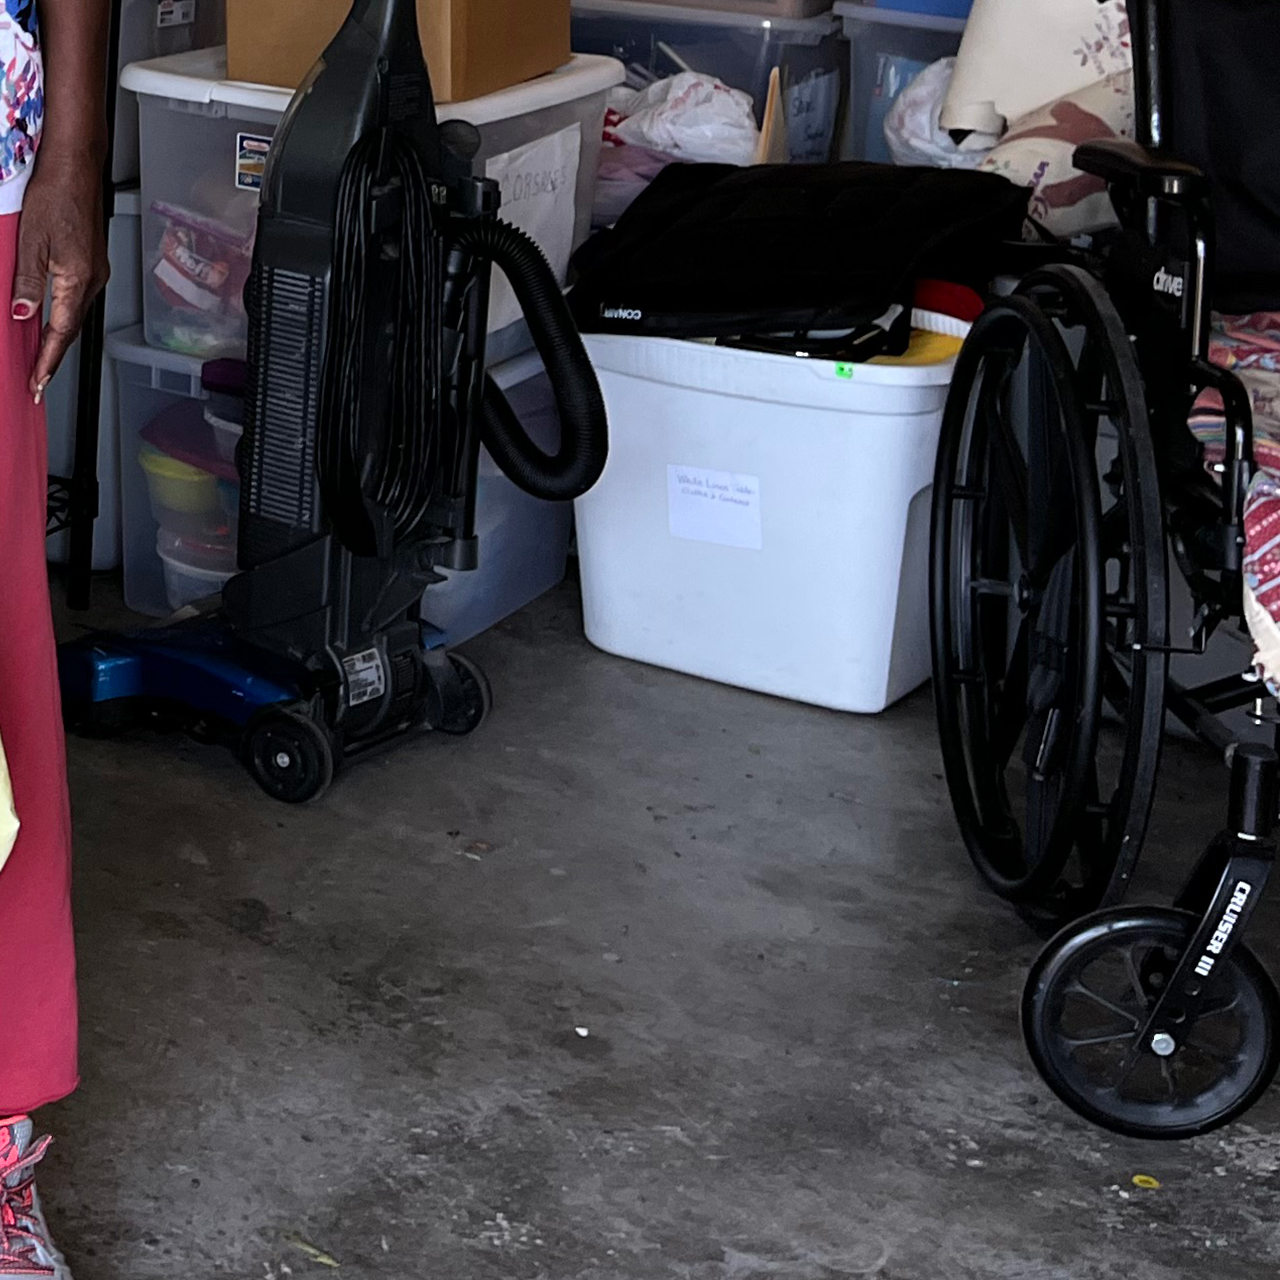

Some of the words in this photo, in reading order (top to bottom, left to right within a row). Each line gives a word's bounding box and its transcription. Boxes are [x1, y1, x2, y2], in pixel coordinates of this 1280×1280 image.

[1153, 265, 1183, 297] drive
[1206, 880, 1252, 954] CRUISER
[1194, 954, 1215, 977] III
